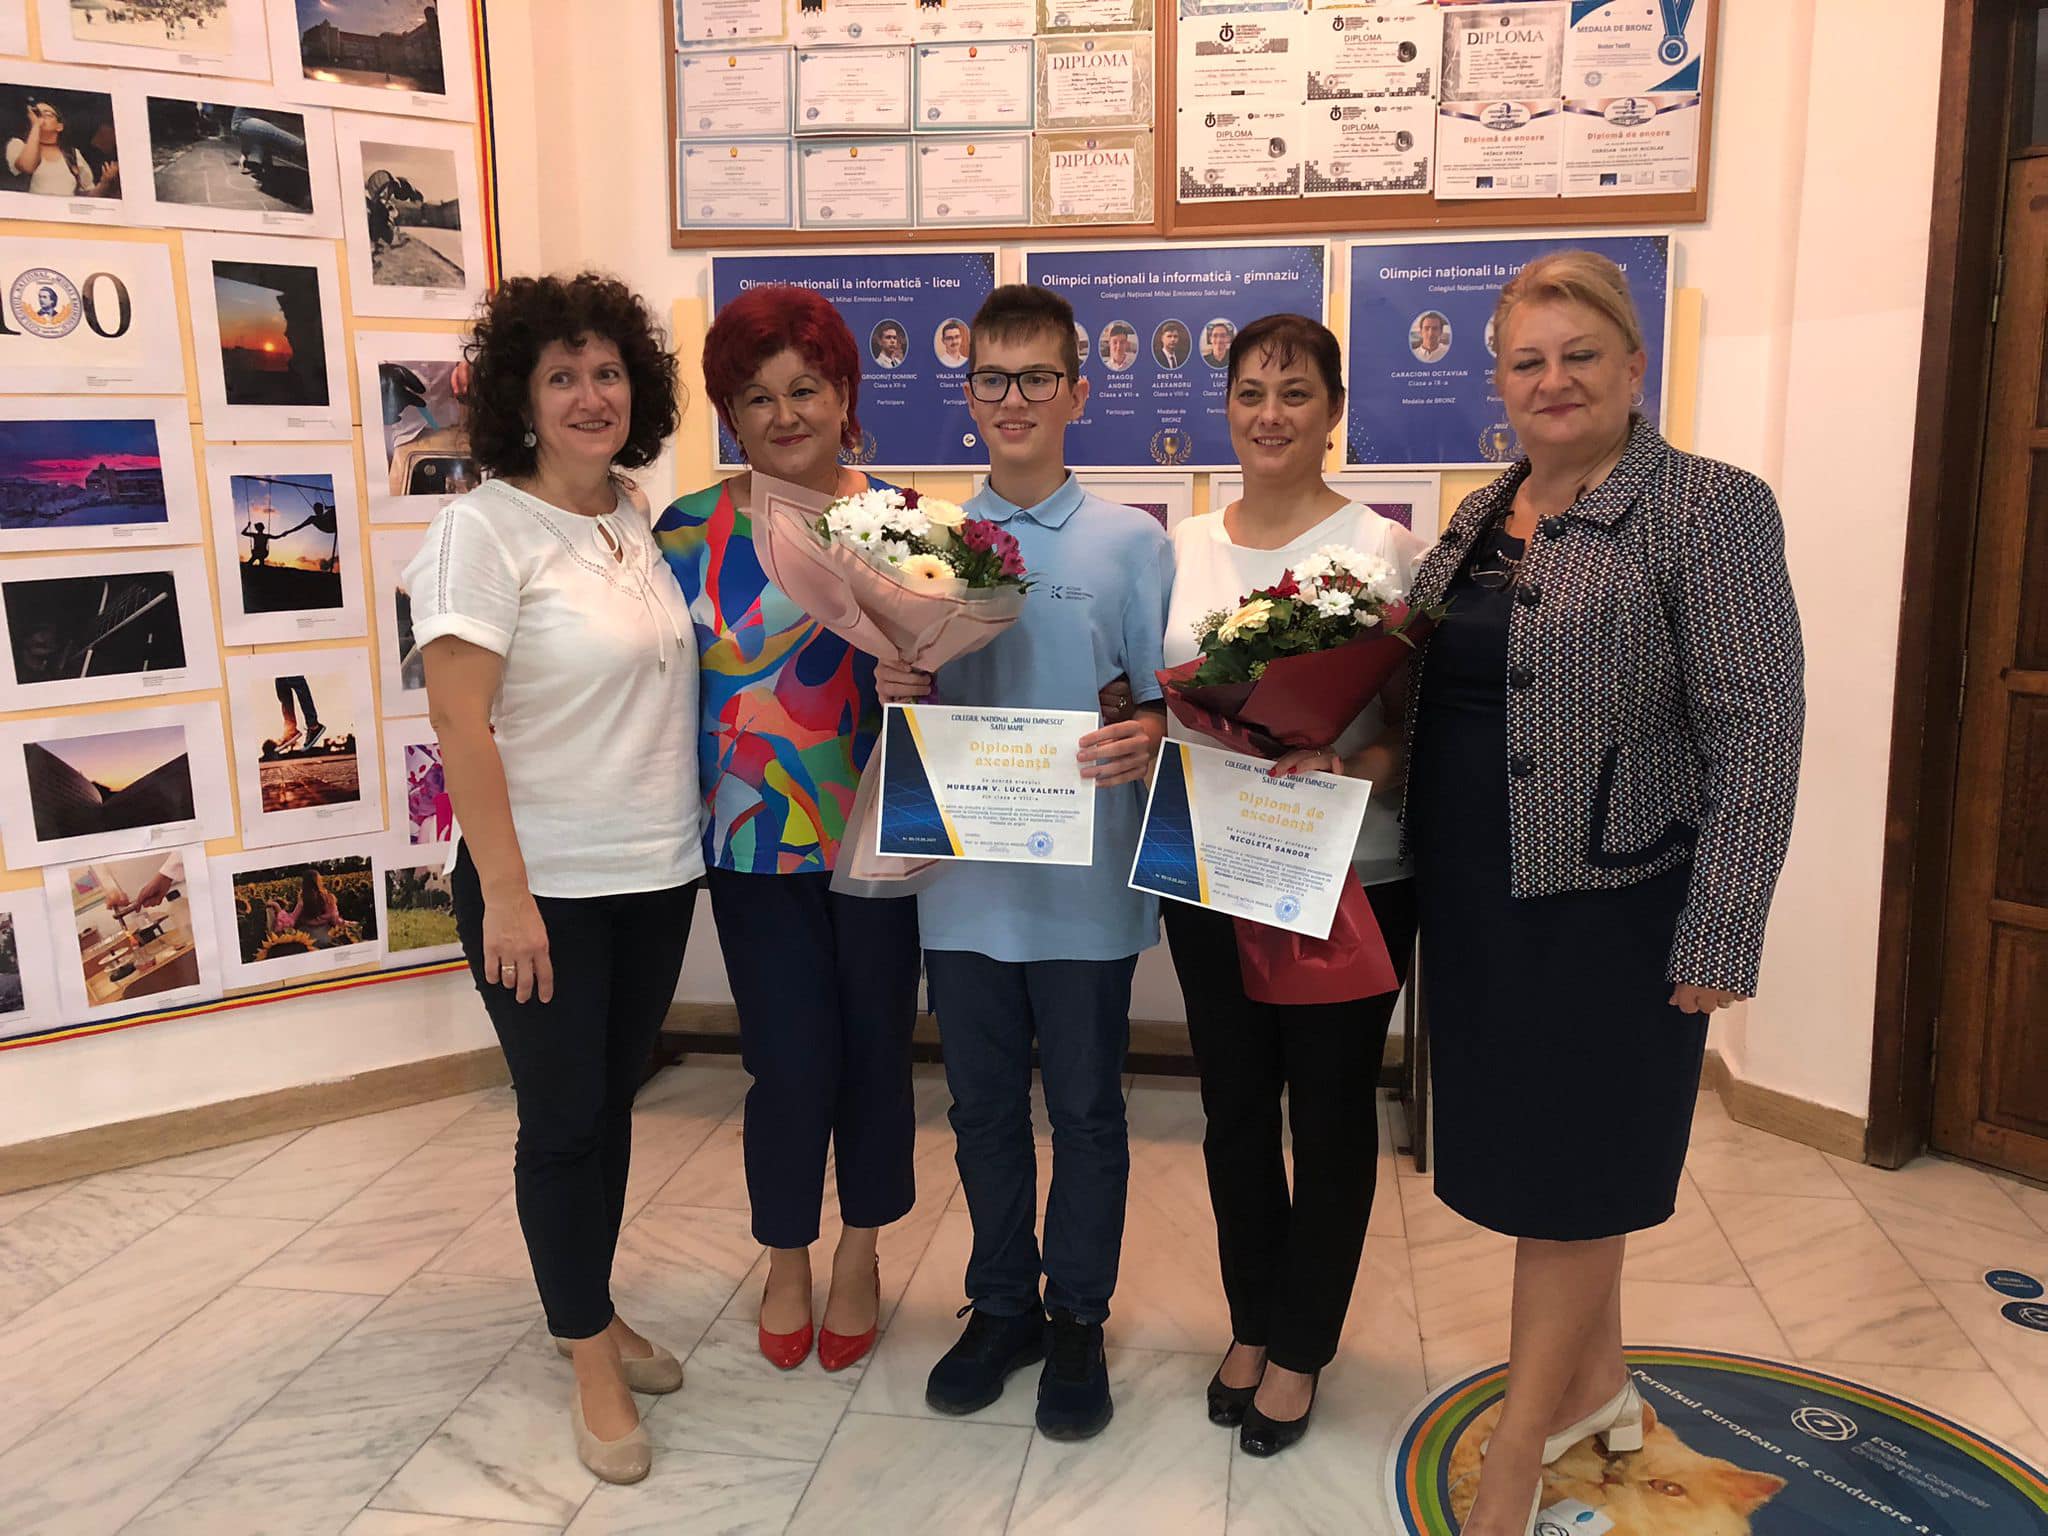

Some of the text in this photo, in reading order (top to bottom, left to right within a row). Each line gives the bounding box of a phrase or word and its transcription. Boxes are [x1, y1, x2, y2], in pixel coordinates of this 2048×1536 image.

[1577, 25, 1613, 33] MEDALIA
[1625, 24, 1653, 32] BRONZ
[1344, 34, 1382, 42] DIPLOMA
[1466, 30, 1544, 46] DIPLOMA
[1053, 54, 1128, 70] DIPLOMA
[1216, 130, 1253, 138] DIPLOMA
[1342, 123, 1380, 132] DIPLOMA
[1055, 153, 1130, 168] DIPLOMA
[1042, 274, 1090, 288] Olimpici
[1094, 273, 1146, 288] naționali
[1149, 272, 1159, 283] la
[1163, 271, 1232, 284] informatică
[1244, 269, 1299, 284] gimnaziu
[1380, 268, 1432, 281] Olimpici
[1436, 266, 1491, 280] naționali
[1495, 265, 1505, 276] la
[843, 278, 853, 289] la
[856, 277, 921, 289] informatică
[932, 276, 960, 288] liceu
[1100, 291, 1126, 300] Colegiul
[1127, 290, 1152, 298] Național
[1173, 289, 1203, 297] Eminescu
[952, 714, 978, 722] COLEGIUL
[970, 740, 1057, 754] Diplomă de
[975, 757, 1050, 771] excelență
[1225, 760, 1251, 772] COLEGIUL
[947, 784, 988, 792] MUREȘAN
[1262, 776, 1296, 790] SATU MARE
[1239, 791, 1325, 820] Diplomă de
[1230, 835, 1272, 850] NICOLETA
[1632, 1369, 1702, 1409] Permisul
[1702, 1408, 1782, 1455] european
[1786, 1454, 1809, 1469] de
[1813, 1469, 1912, 1524] conducere
[1870, 1436, 1908, 1458] ECDL
[1851, 1446, 1896, 1472] Driving
[1862, 1442, 1991, 1510] European Computer
